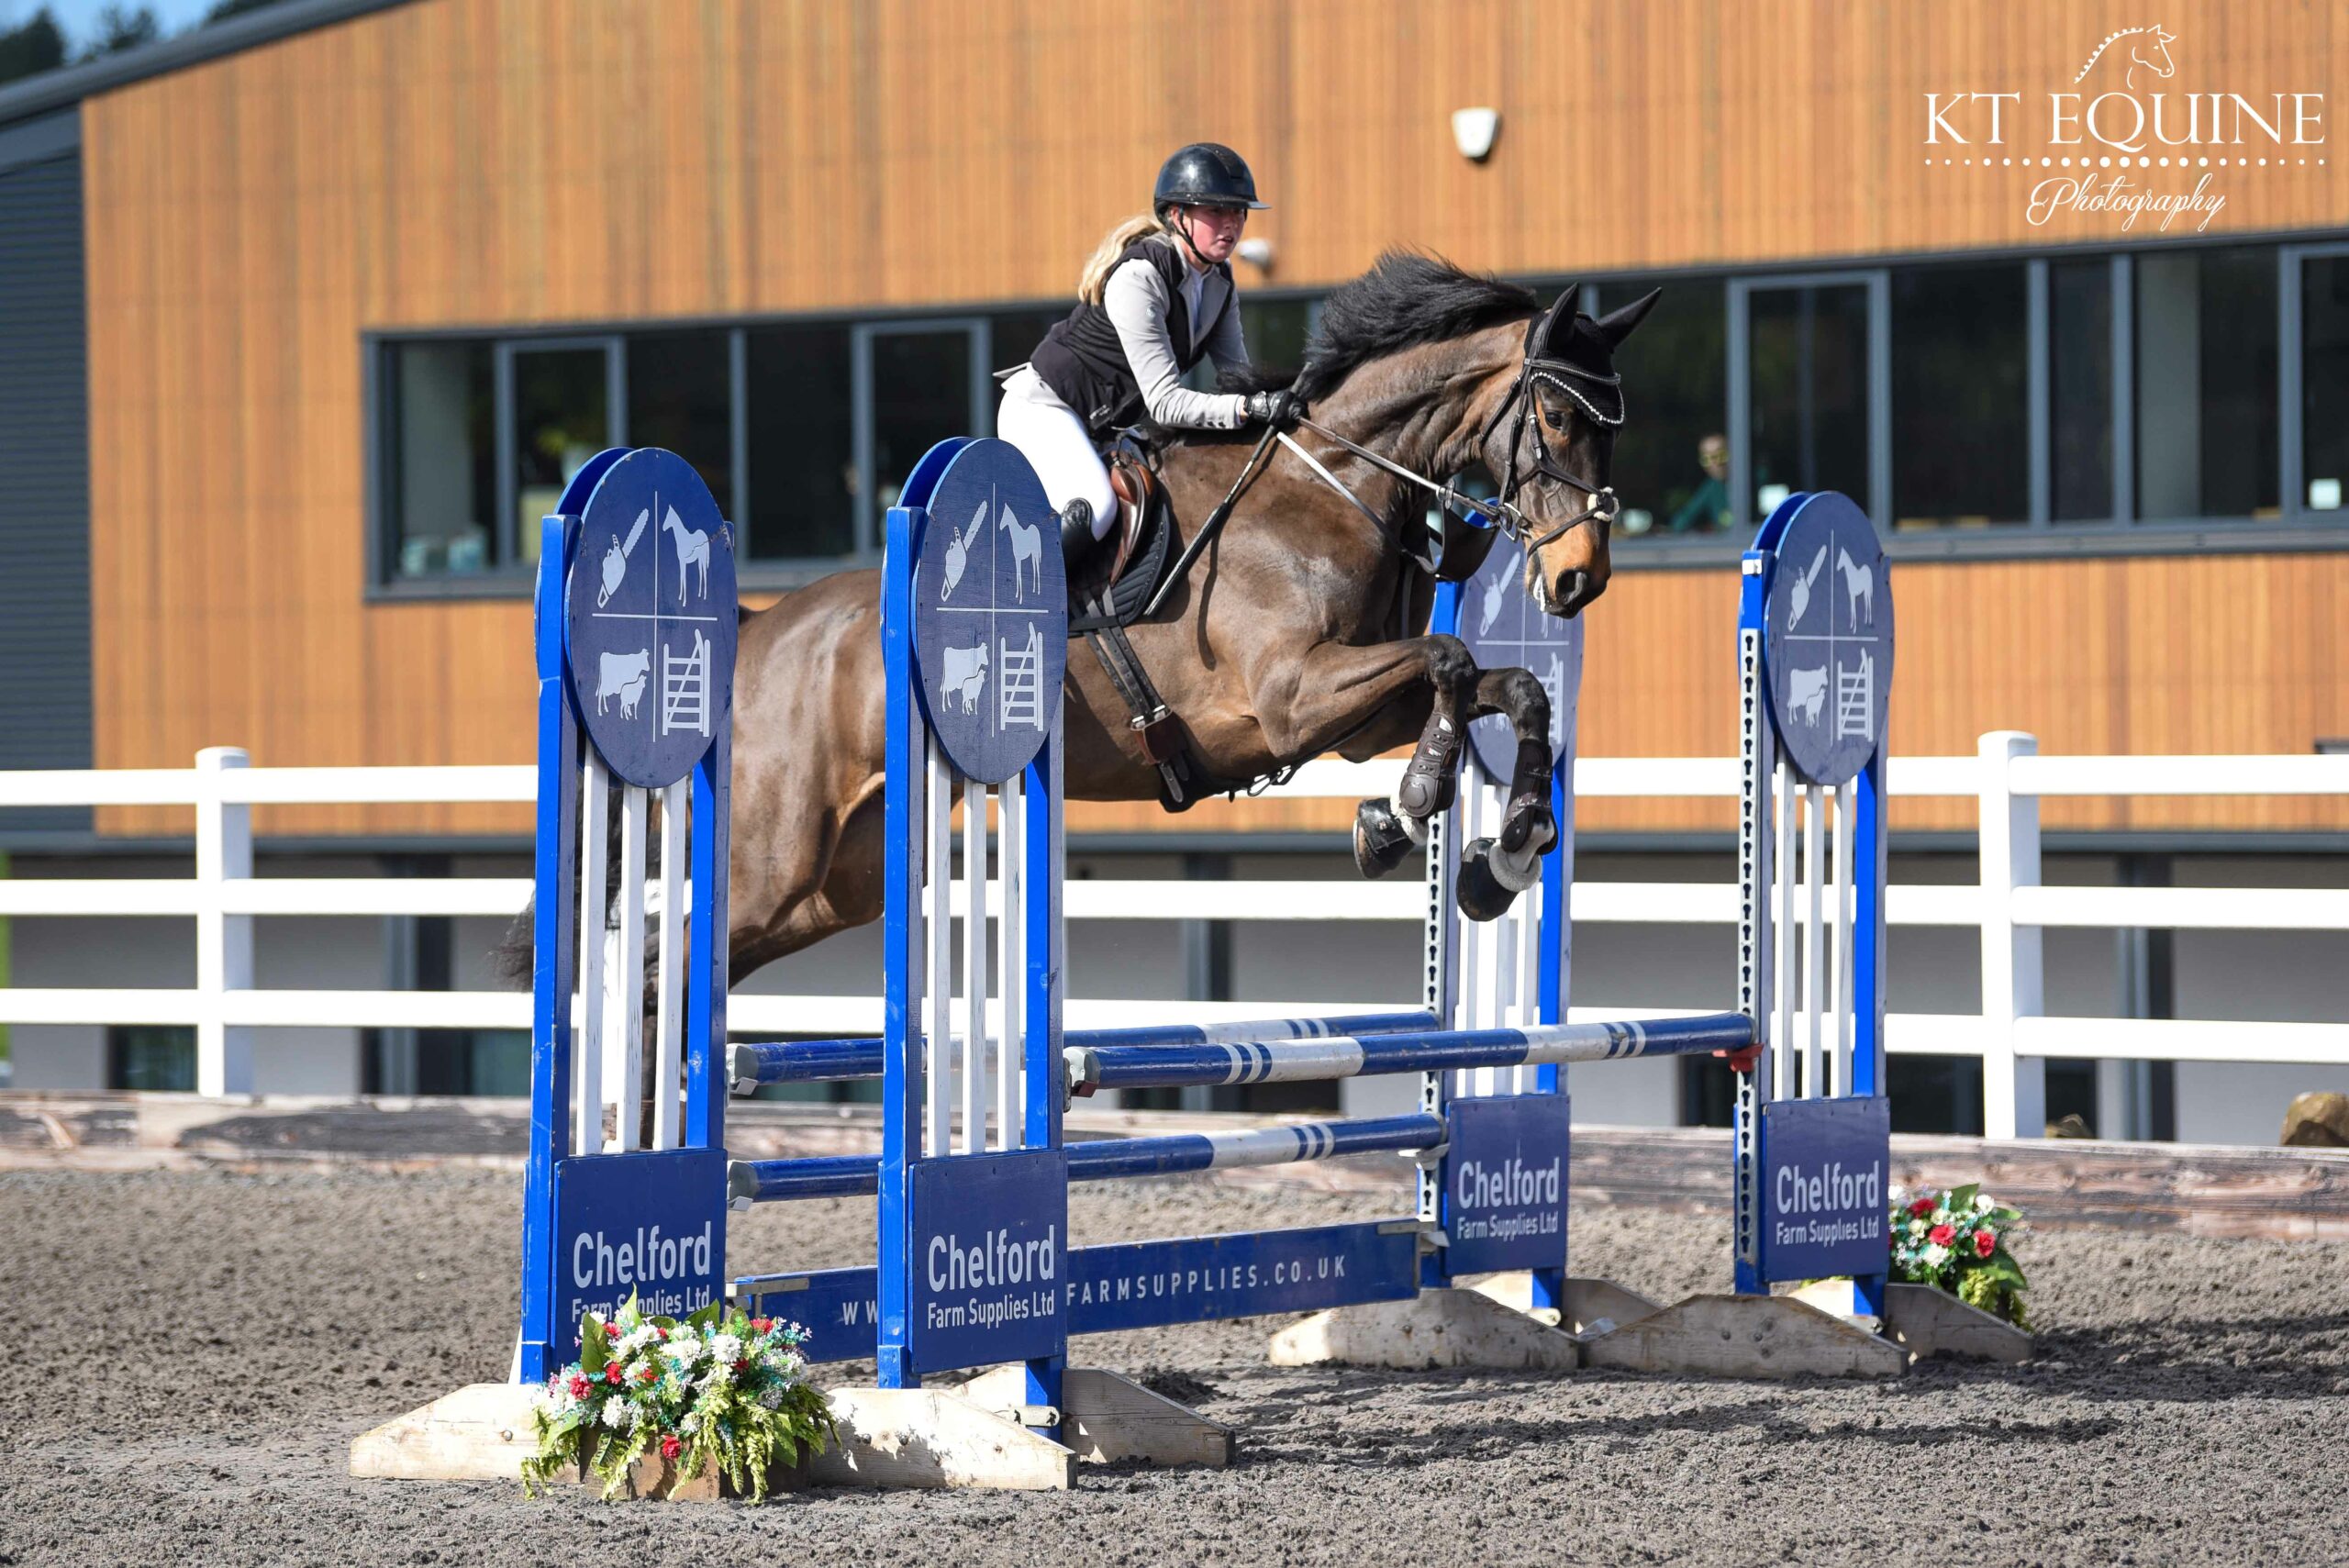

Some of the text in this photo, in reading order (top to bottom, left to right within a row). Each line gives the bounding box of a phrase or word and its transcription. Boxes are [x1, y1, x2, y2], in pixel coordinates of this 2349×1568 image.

[1458, 1156, 1560, 1209] Chelford
[1776, 1160, 1879, 1214] Chelford
[1456, 1211, 1559, 1242] Farm Supplies Ltd
[1776, 1215, 1879, 1248] Farm Supplies Ltd
[573, 1220, 711, 1289] Chelford
[928, 1224, 1054, 1293] Chelford
[617, 1288, 682, 1316] Spplies
[686, 1284, 710, 1312] Ltd
[928, 1289, 1054, 1329] Farm Supplies Ltd
